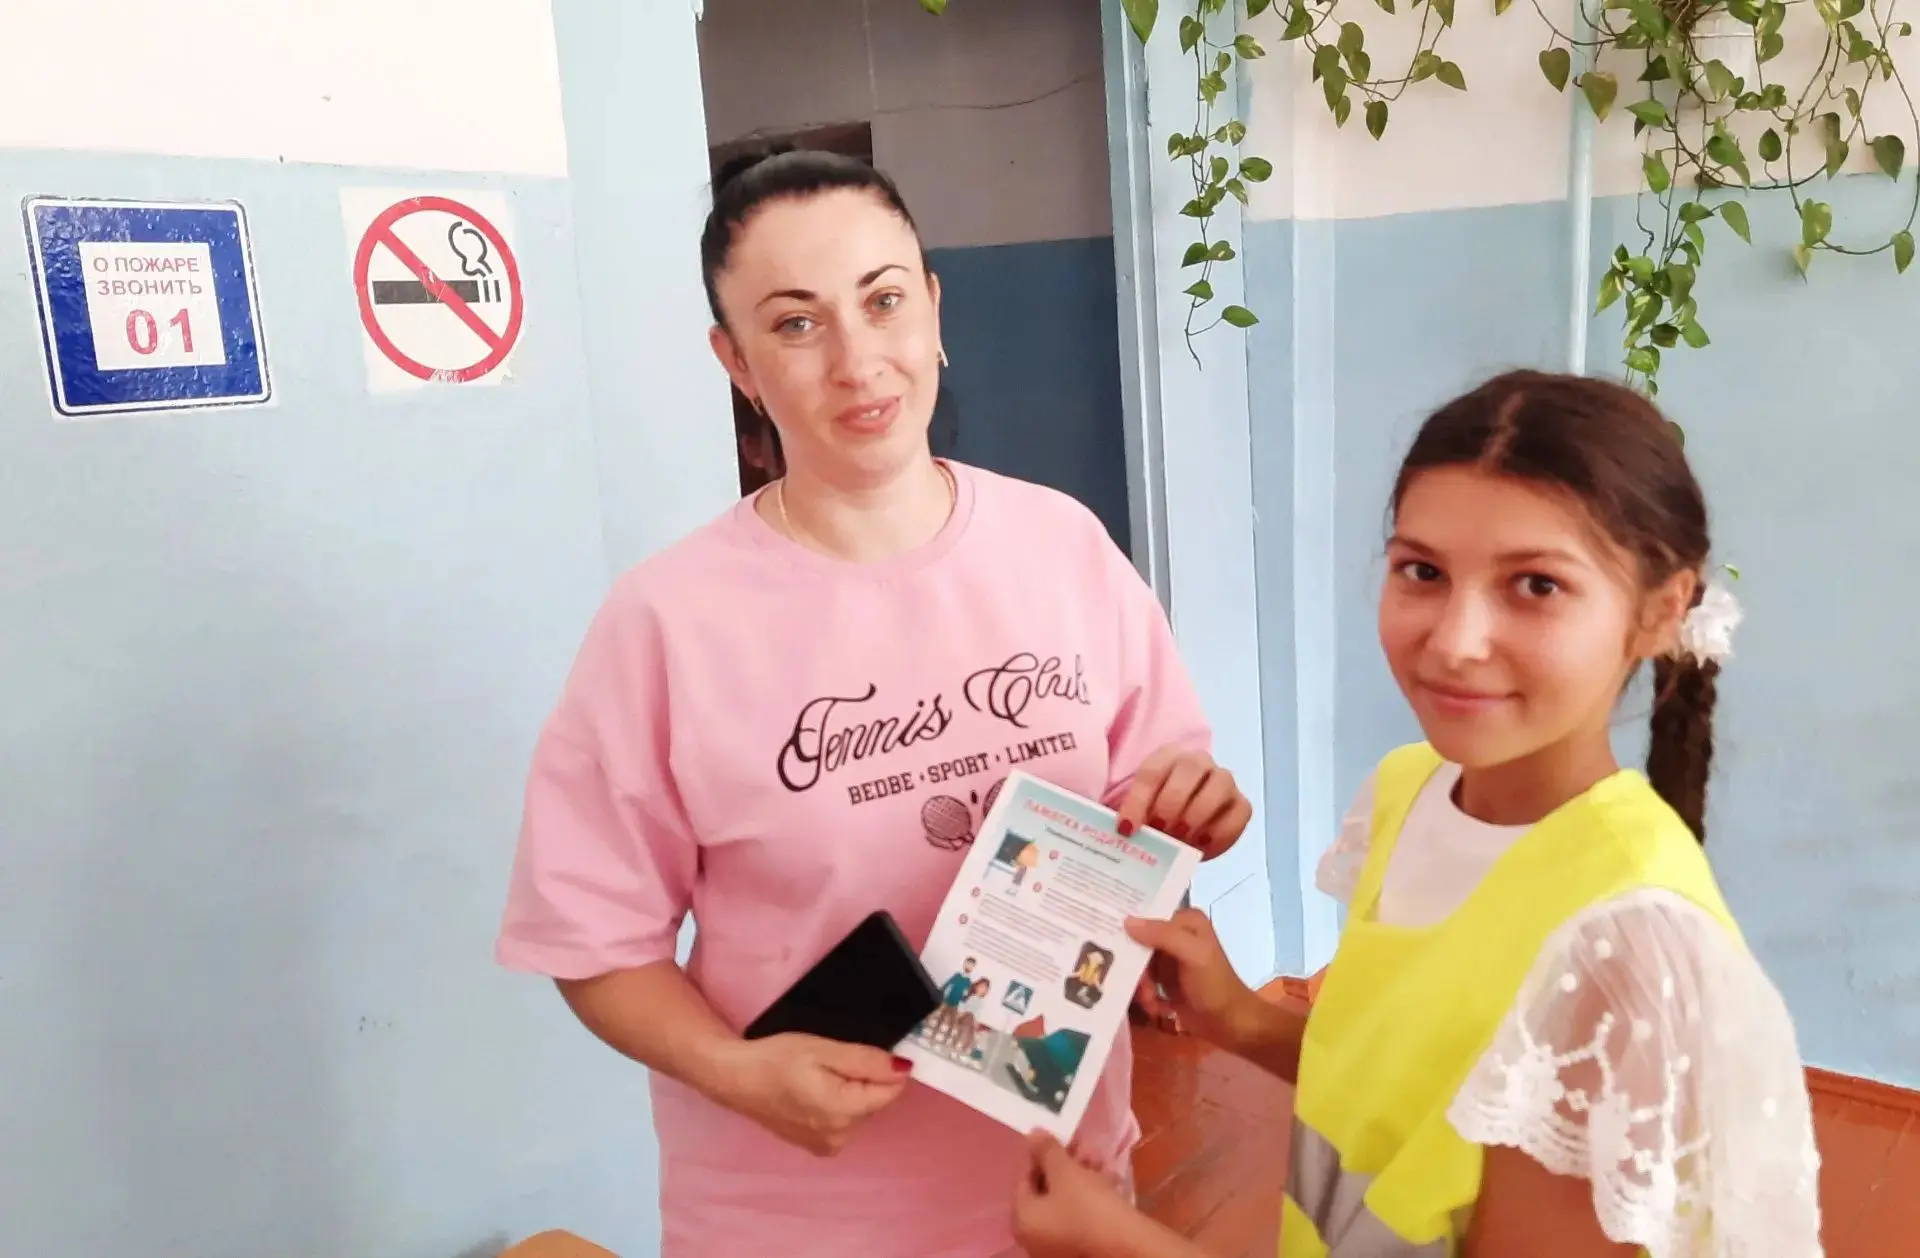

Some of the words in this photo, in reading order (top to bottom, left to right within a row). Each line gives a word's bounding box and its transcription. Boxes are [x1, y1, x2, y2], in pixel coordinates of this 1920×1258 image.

[94, 256, 109, 273] О
[115, 256, 200, 274] ПОЖАРЕ
[97, 279, 203, 296] ЗВОНИТЬ
[126, 308, 194, 355] 01
[777, 683, 954, 792] Tennis
[847, 772, 915, 805] BEDBE
[928, 753, 989, 783] SPORT
